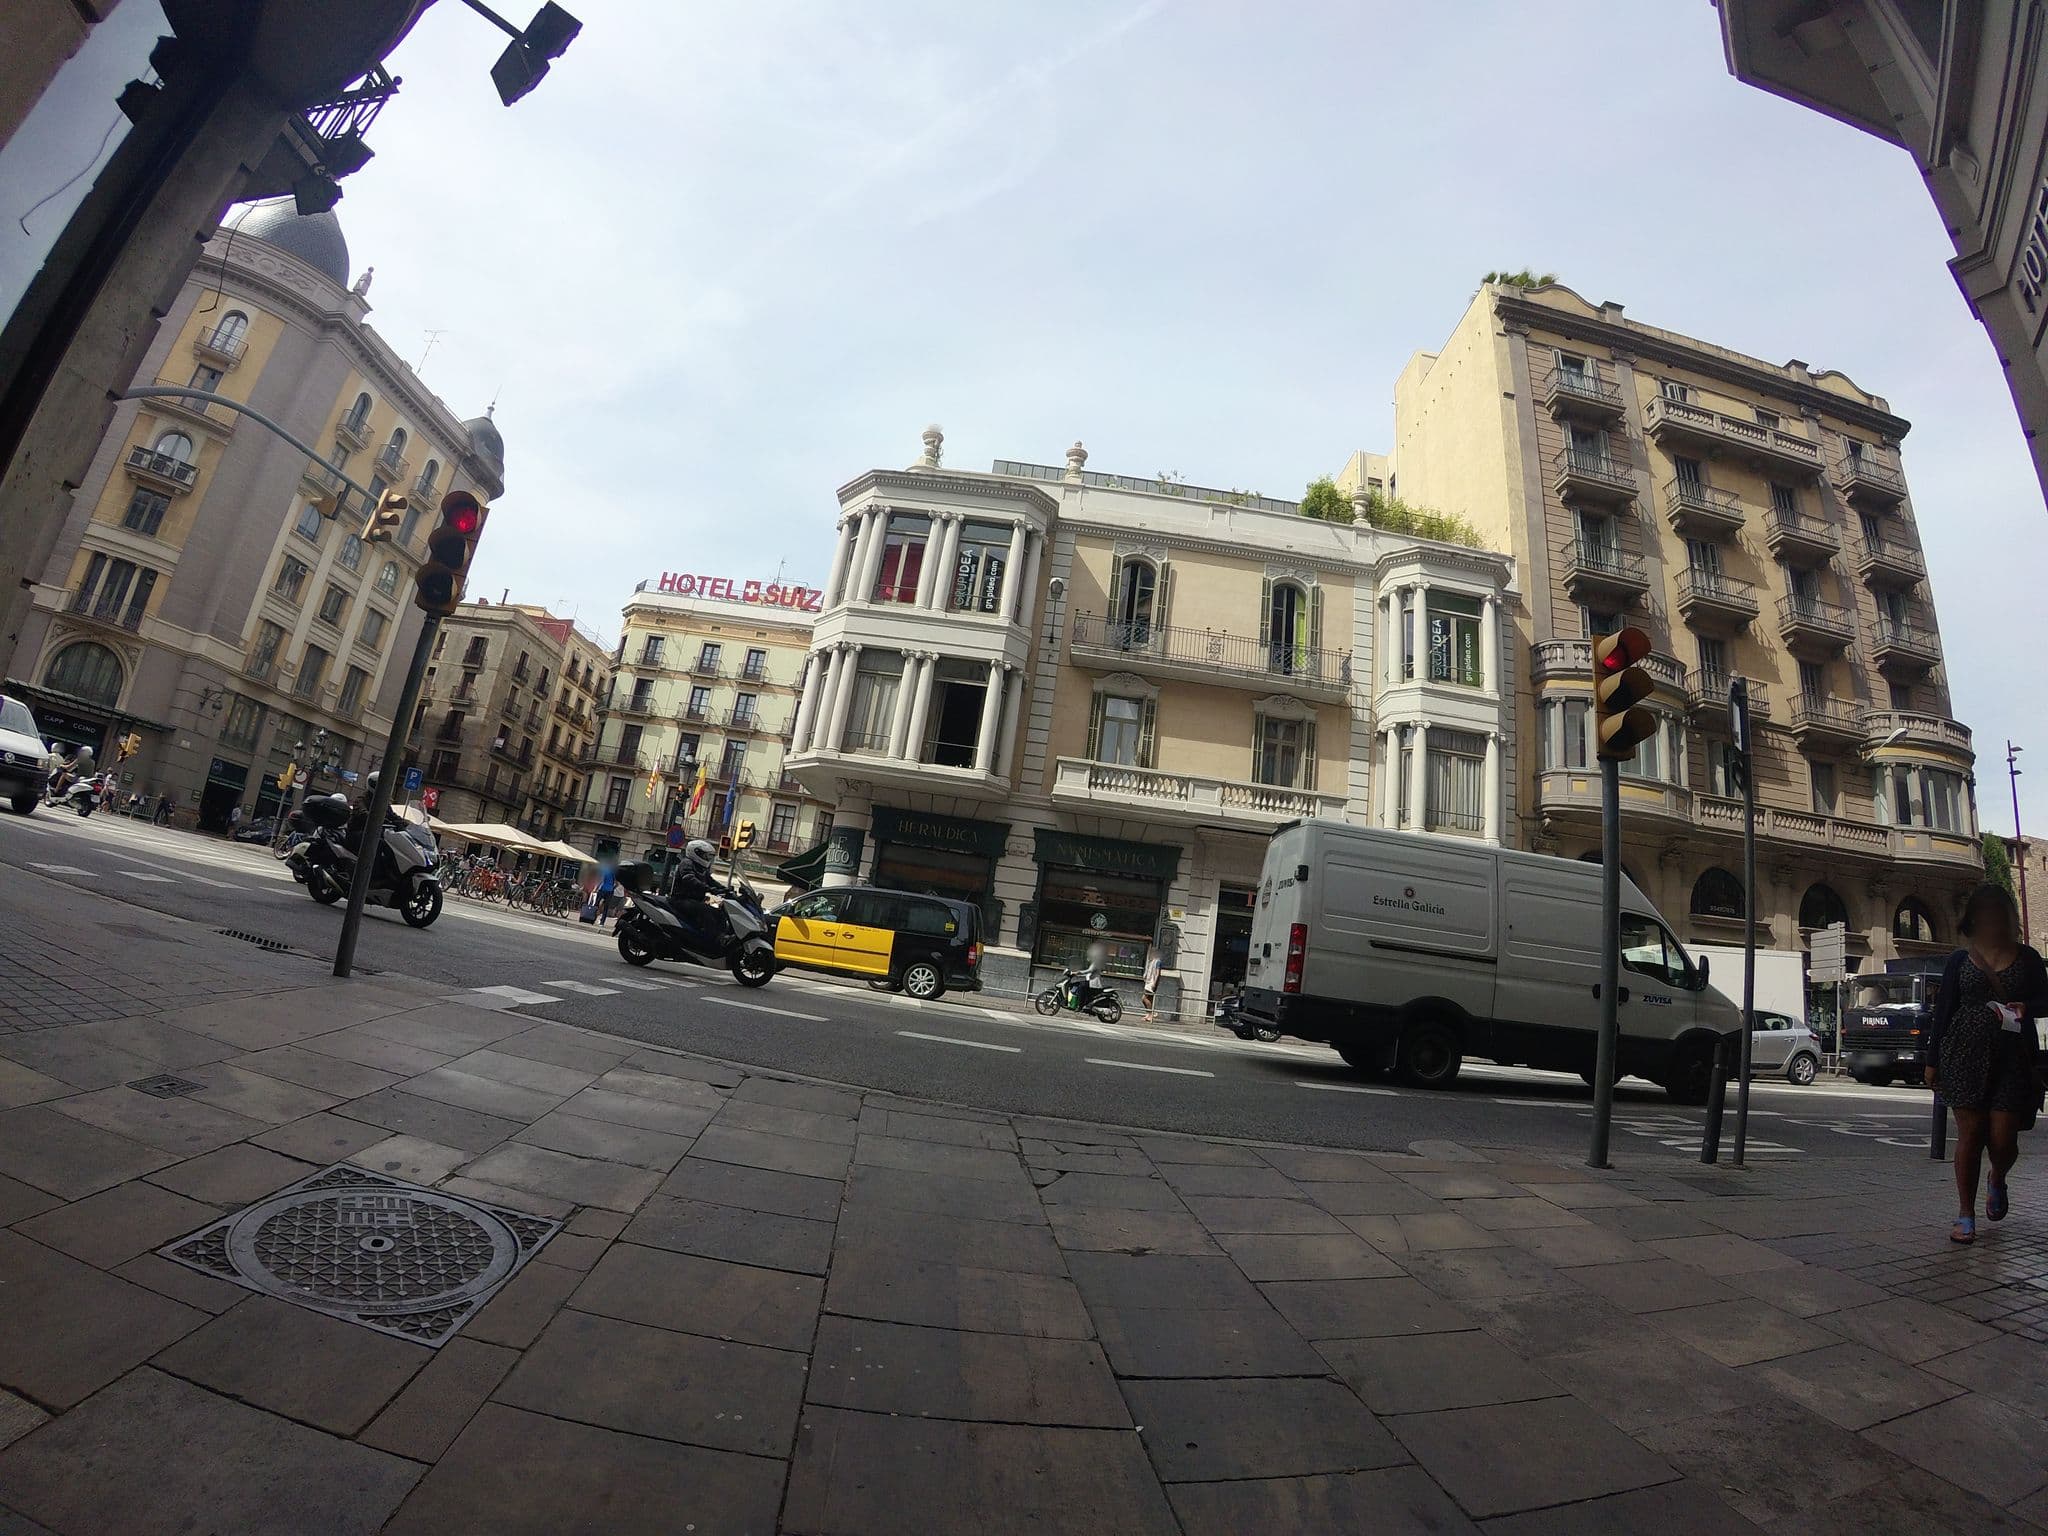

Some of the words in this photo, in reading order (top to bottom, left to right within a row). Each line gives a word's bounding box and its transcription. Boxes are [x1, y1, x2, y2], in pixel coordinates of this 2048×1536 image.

[659, 571, 739, 600] HOTEL
[411, 771, 418, 780] P
[1373, 894, 1410, 910] Estrella
[1412, 900, 1445, 915] Galicia
[1642, 995, 1672, 1004] ZUVISA
